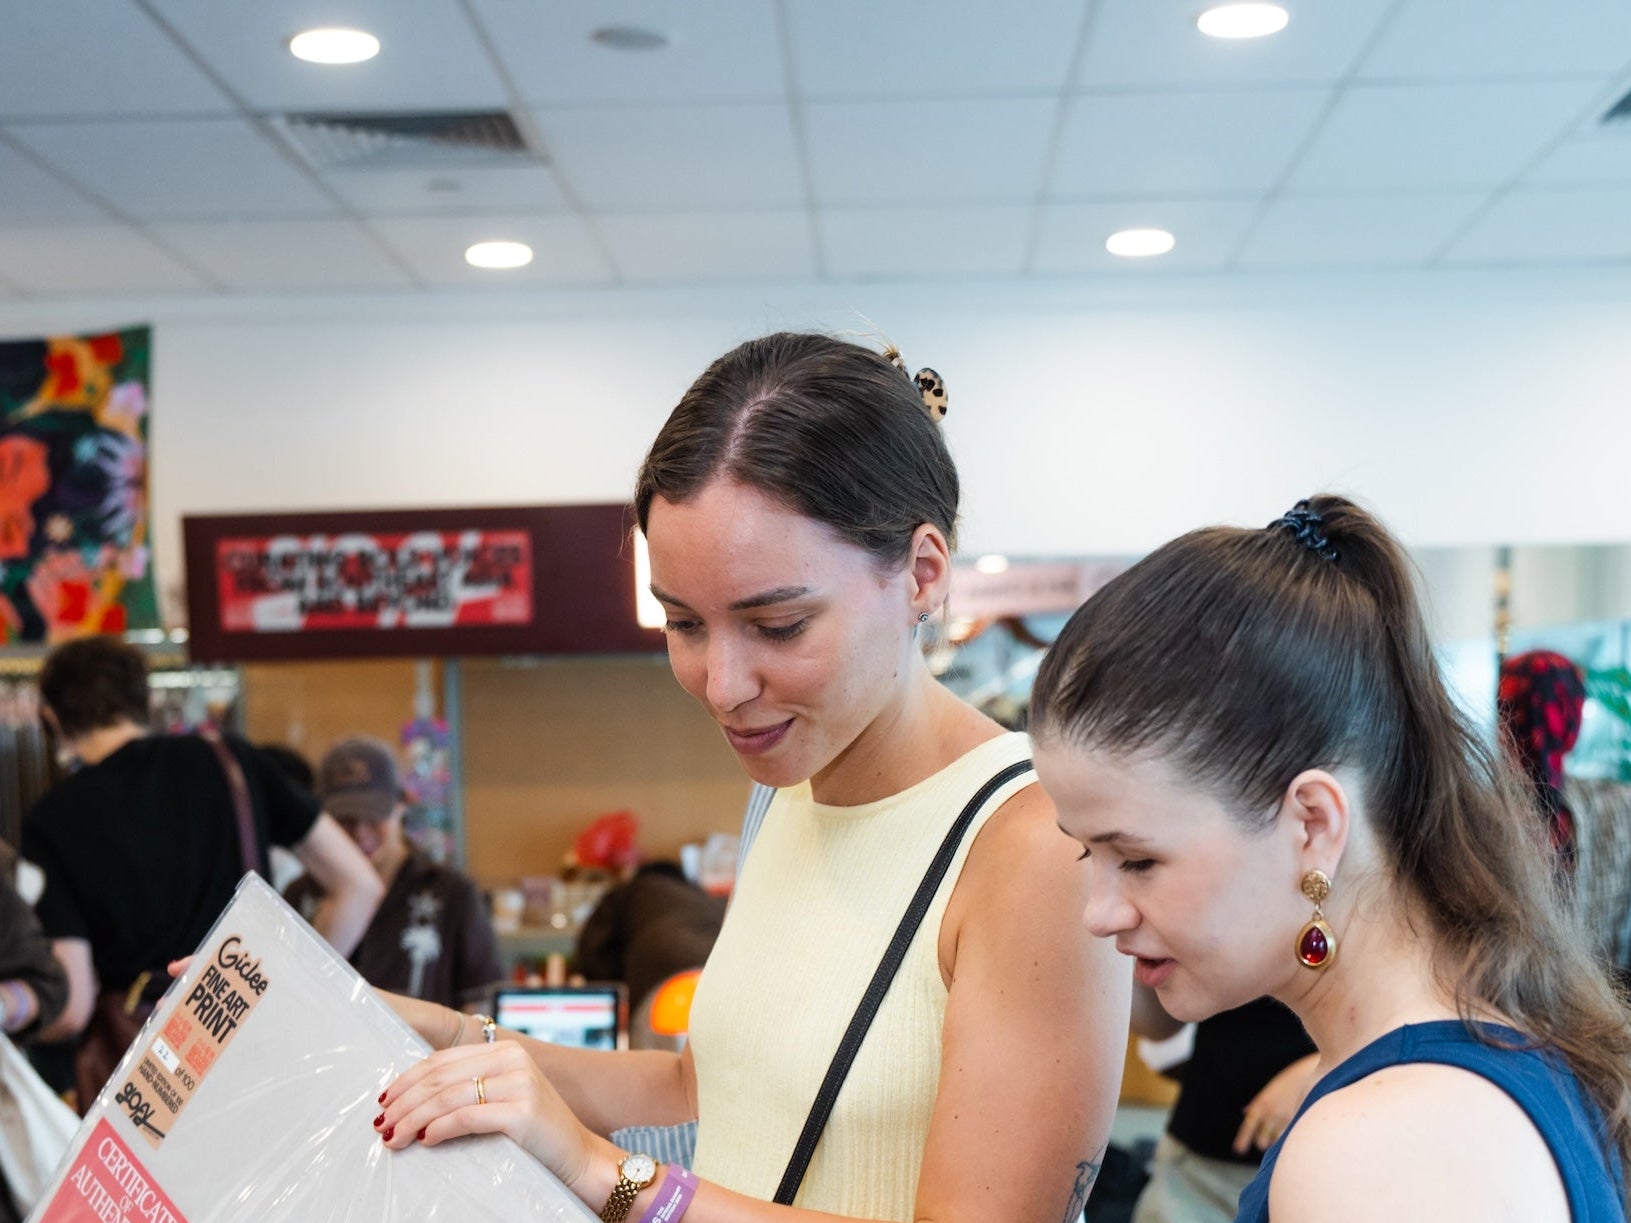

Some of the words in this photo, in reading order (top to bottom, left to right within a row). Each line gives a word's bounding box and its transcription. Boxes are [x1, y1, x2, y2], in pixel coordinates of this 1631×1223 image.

[202, 965, 231, 994] FINE
[223, 990, 250, 1021] ART
[218, 935, 269, 997] Giclee
[186, 982, 237, 1044] PRINT
[137, 1062, 179, 1115] HAND-NUMBERED
[173, 1065, 186, 1079] of
[180, 1073, 194, 1092] 100
[118, 1194, 134, 1214] OF
